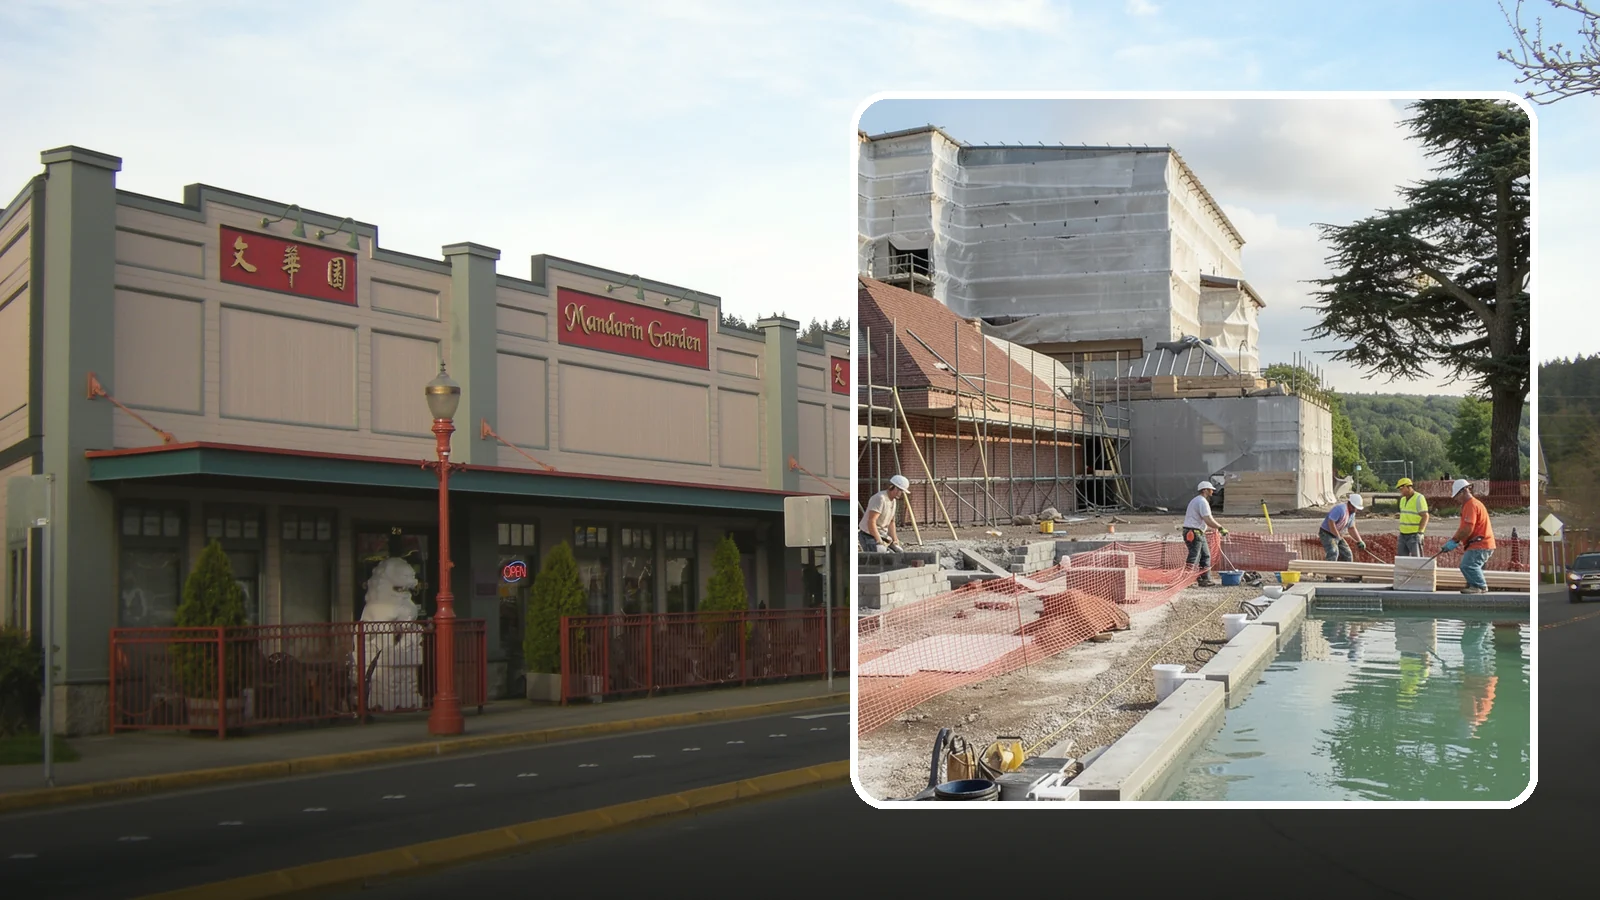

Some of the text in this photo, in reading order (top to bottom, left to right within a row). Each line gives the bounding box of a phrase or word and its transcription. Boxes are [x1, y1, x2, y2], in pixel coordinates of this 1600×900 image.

[230, 235, 346, 291] 文華園
[564, 302, 701, 352] Mandarin Garden
[503, 565, 527, 578] OPEN
